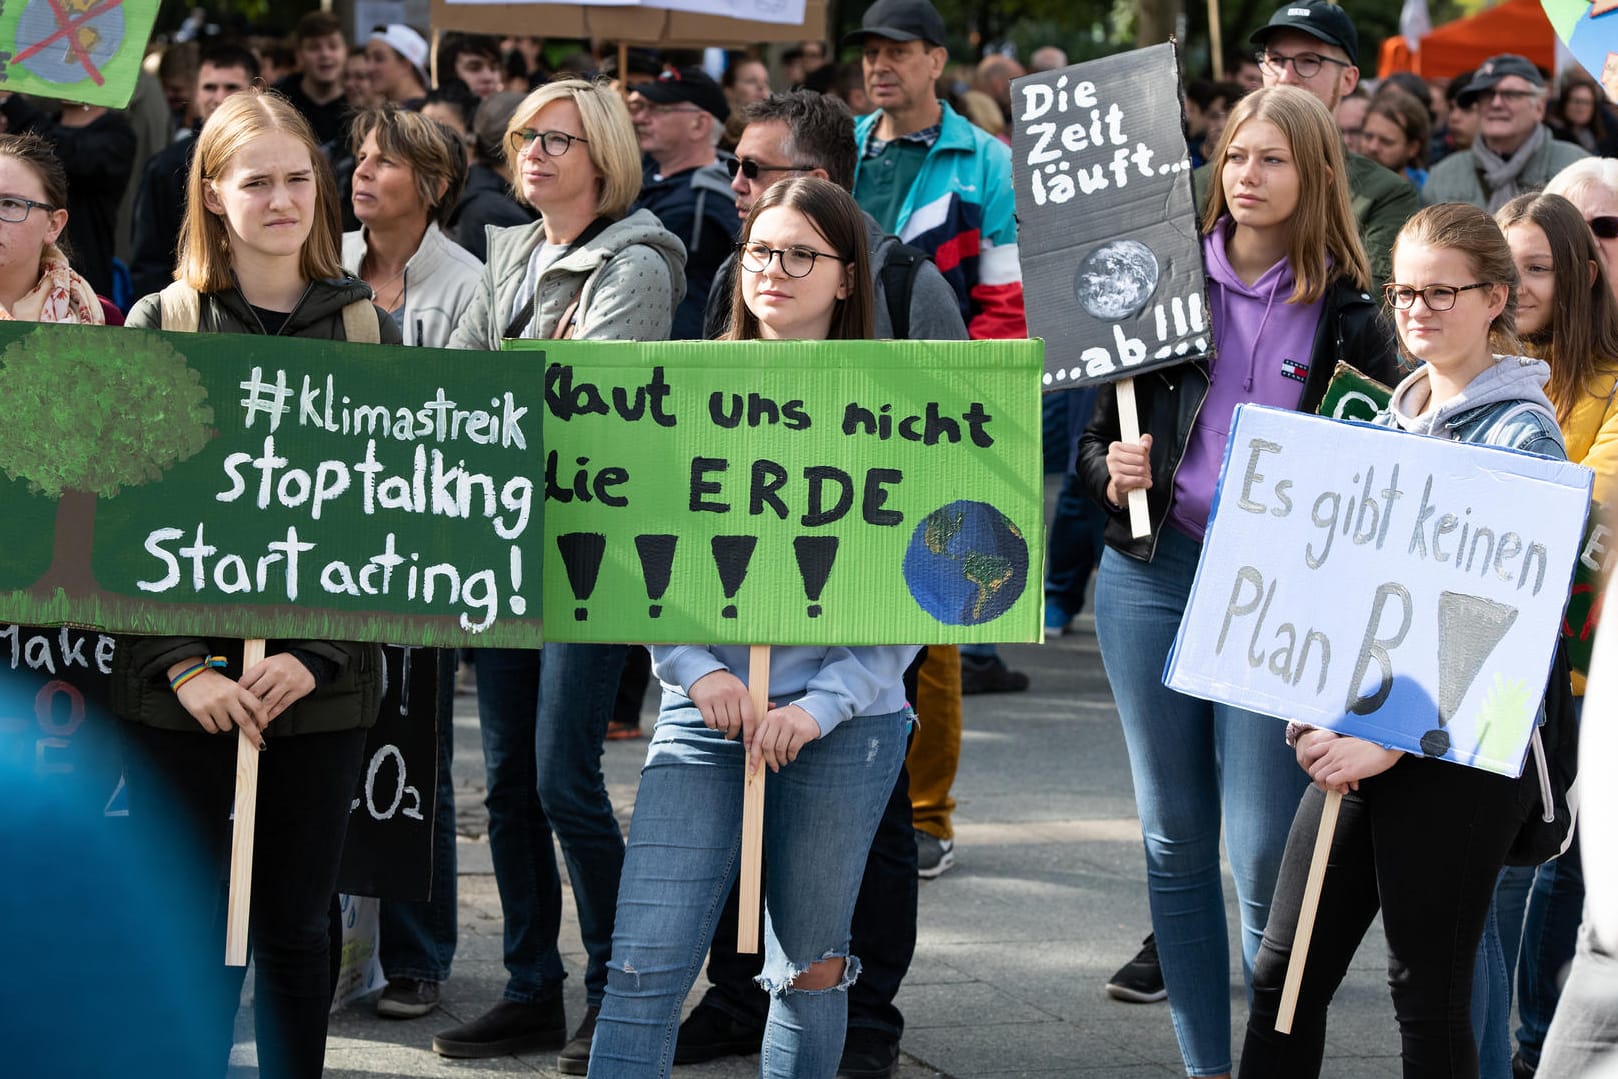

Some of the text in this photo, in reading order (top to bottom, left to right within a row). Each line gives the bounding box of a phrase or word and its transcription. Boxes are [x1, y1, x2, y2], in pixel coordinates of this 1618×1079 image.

[1021, 75, 1097, 121] Die
[1026, 103, 1127, 165] Zeit
[1032, 143, 1190, 206] läuft...
[708, 391, 811, 431] uns
[842, 402, 995, 449] nicht
[689, 456, 904, 528] ERDE
[1237, 438, 1293, 517] Es
[1305, 466, 1404, 570] gibt
[1408, 473, 1547, 597] keinen
[136, 522, 527, 635] Start acting!
[1215, 565, 1331, 696] Plan
